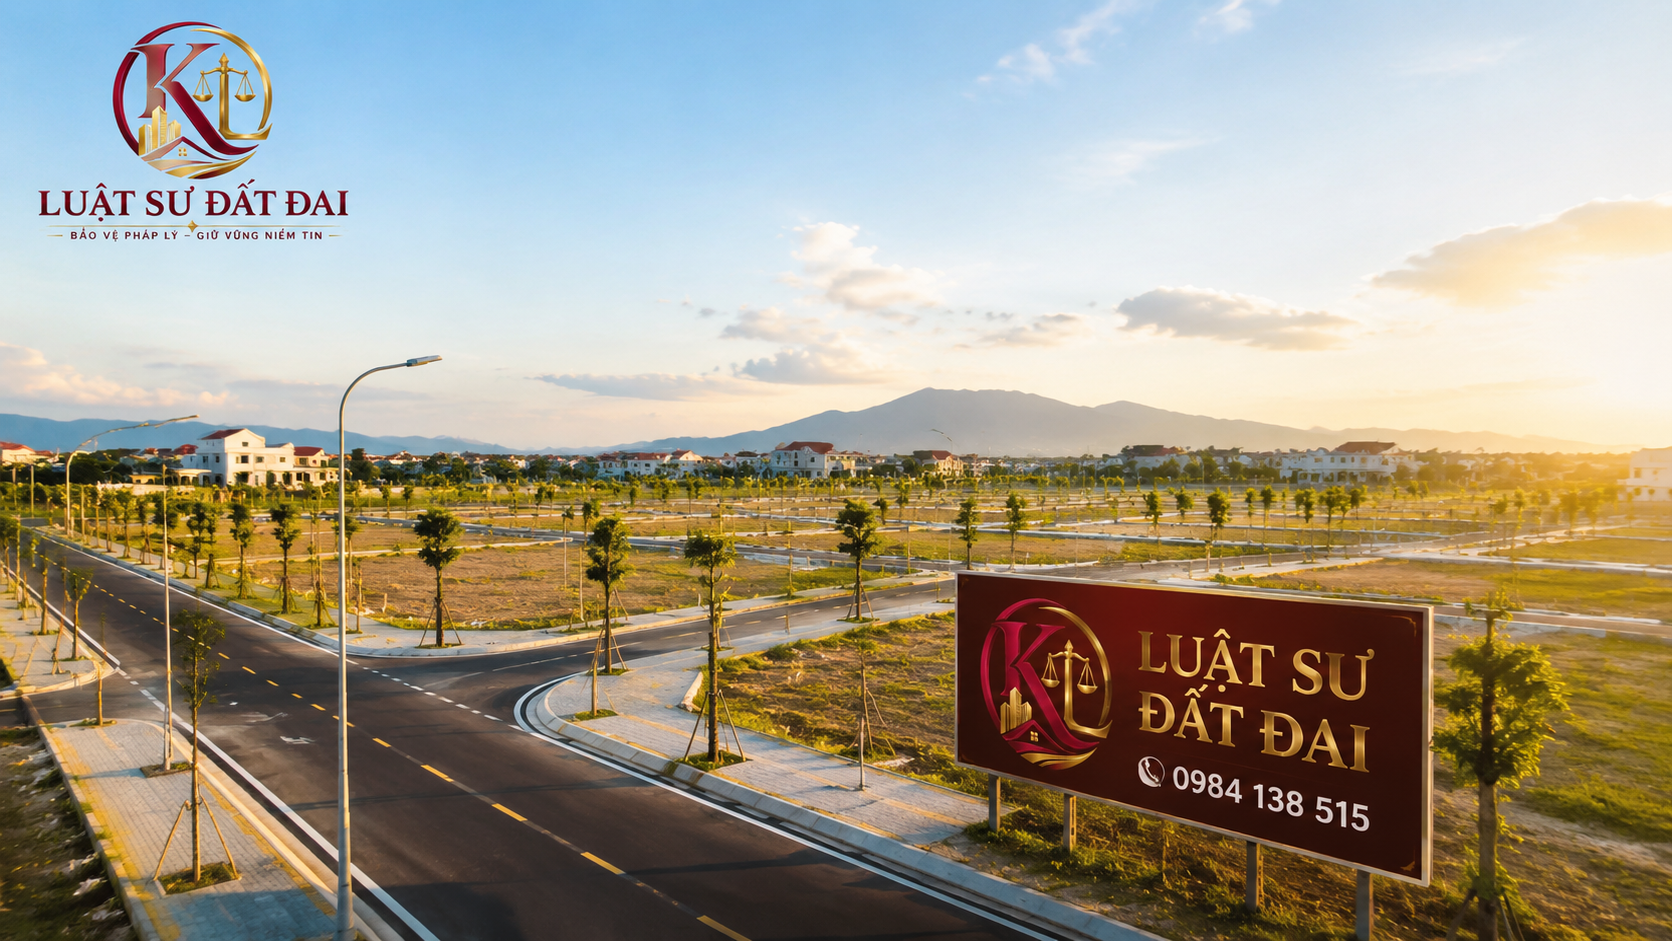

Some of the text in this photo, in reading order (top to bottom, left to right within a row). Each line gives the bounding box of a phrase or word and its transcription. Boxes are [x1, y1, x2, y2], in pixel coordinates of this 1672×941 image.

[1138, 628, 1375, 701] LUẬT SƯ
[1138, 683, 1371, 773] ĐẤT ĐAI
[1172, 766, 1370, 832] 0984 138 515
